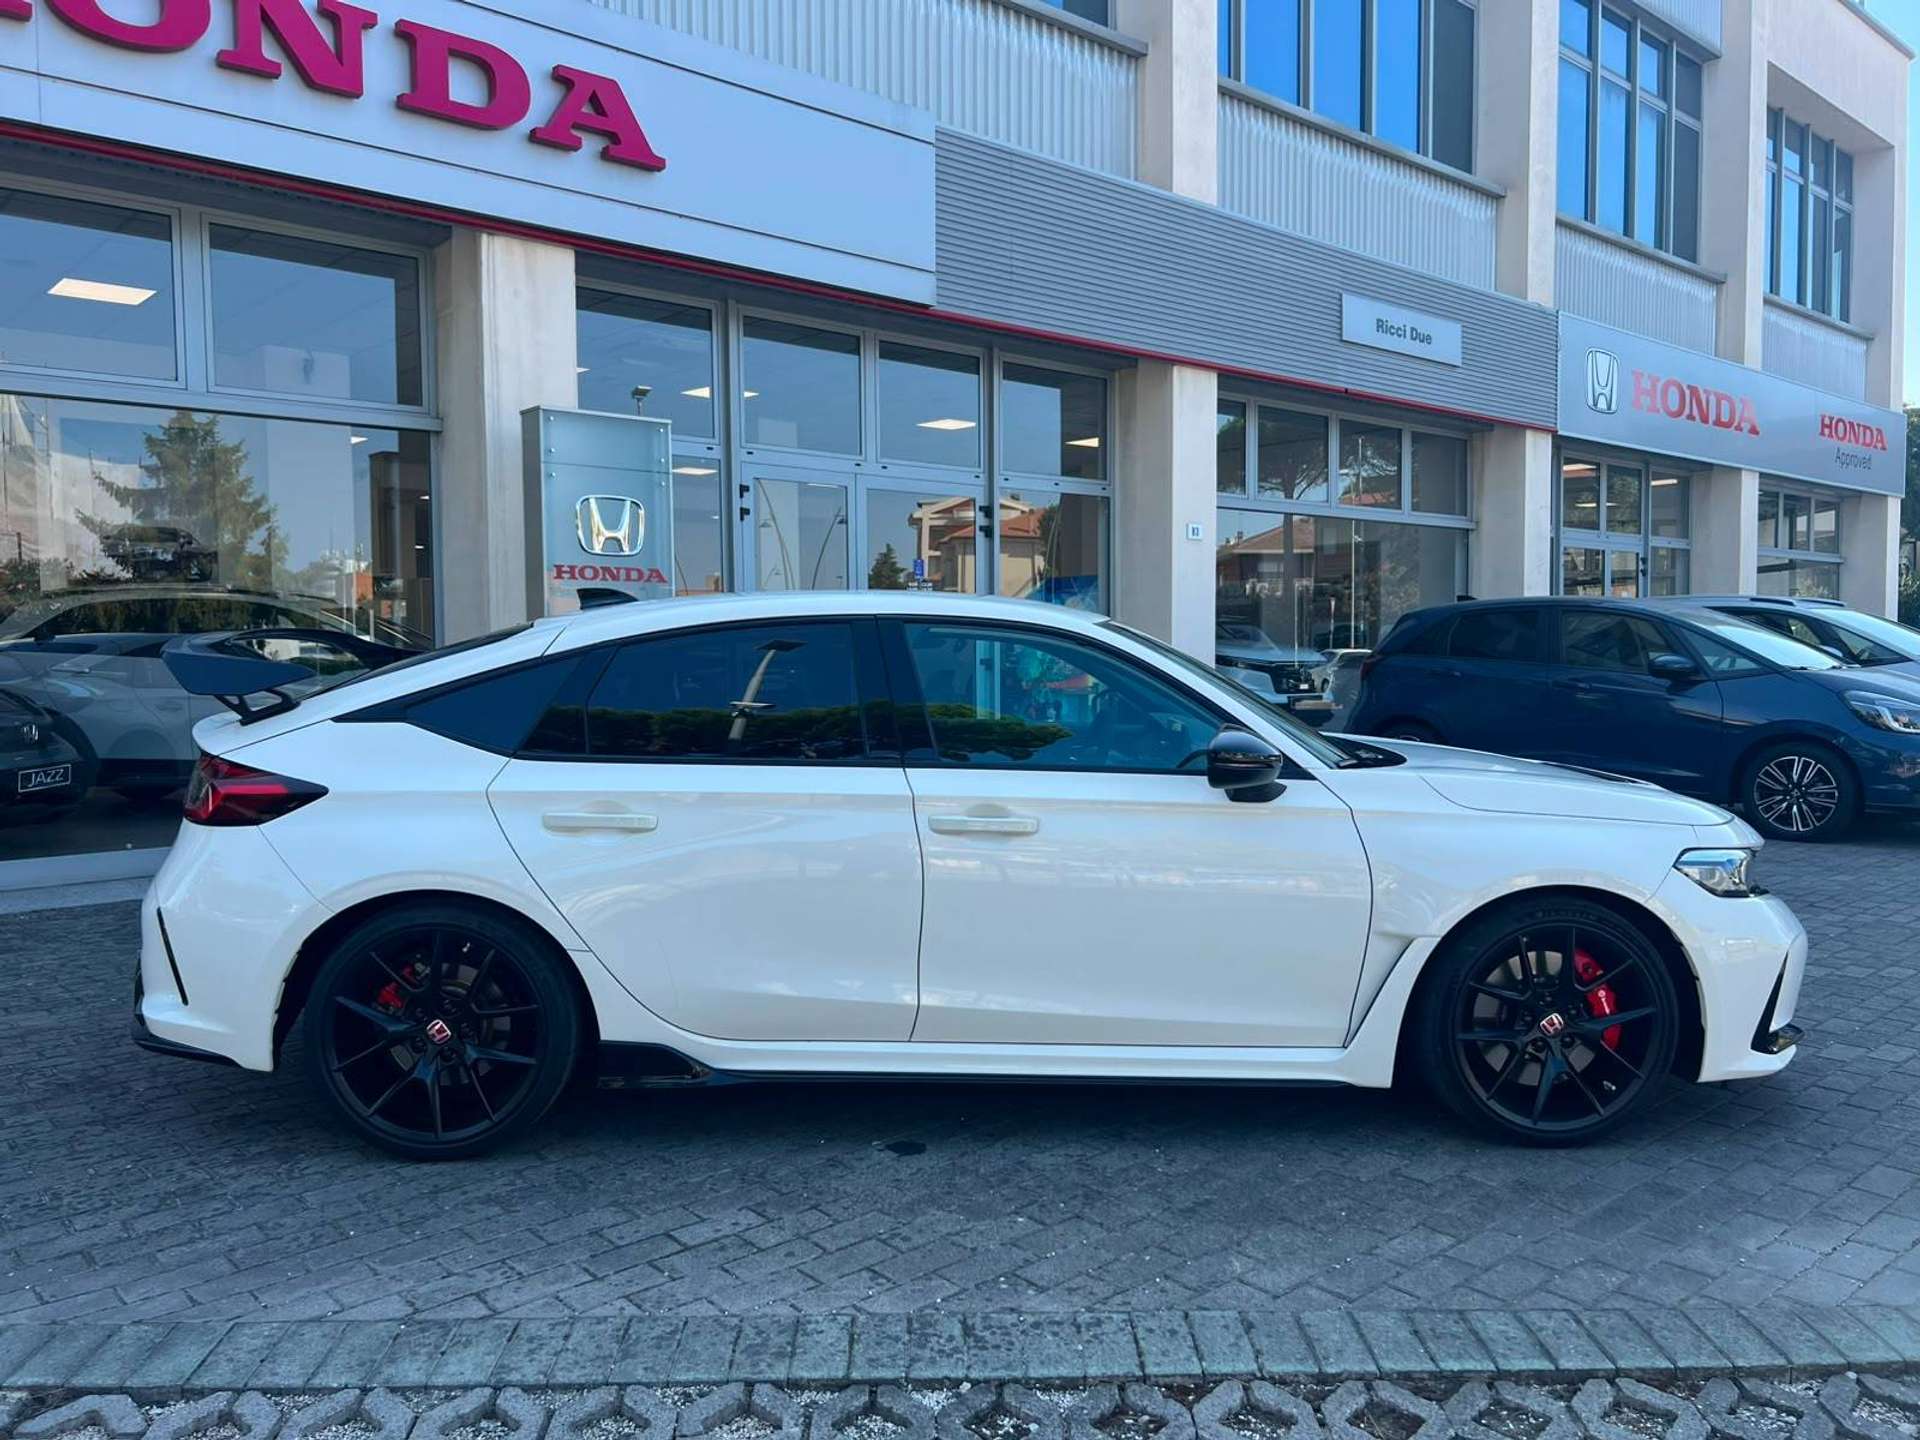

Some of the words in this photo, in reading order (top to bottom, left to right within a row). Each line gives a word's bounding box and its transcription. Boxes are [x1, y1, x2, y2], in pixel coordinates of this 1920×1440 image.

[0, 0, 666, 172] NDA
[1375, 318, 1407, 340] Ricci
[1410, 326, 1432, 345] Due
[1632, 368, 1760, 436] HONDA
[1819, 414, 1887, 451] HONDA
[1834, 447, 1872, 471] Approved
[553, 564, 668, 584] HONDA
[27, 768, 64, 788] JAZZ
